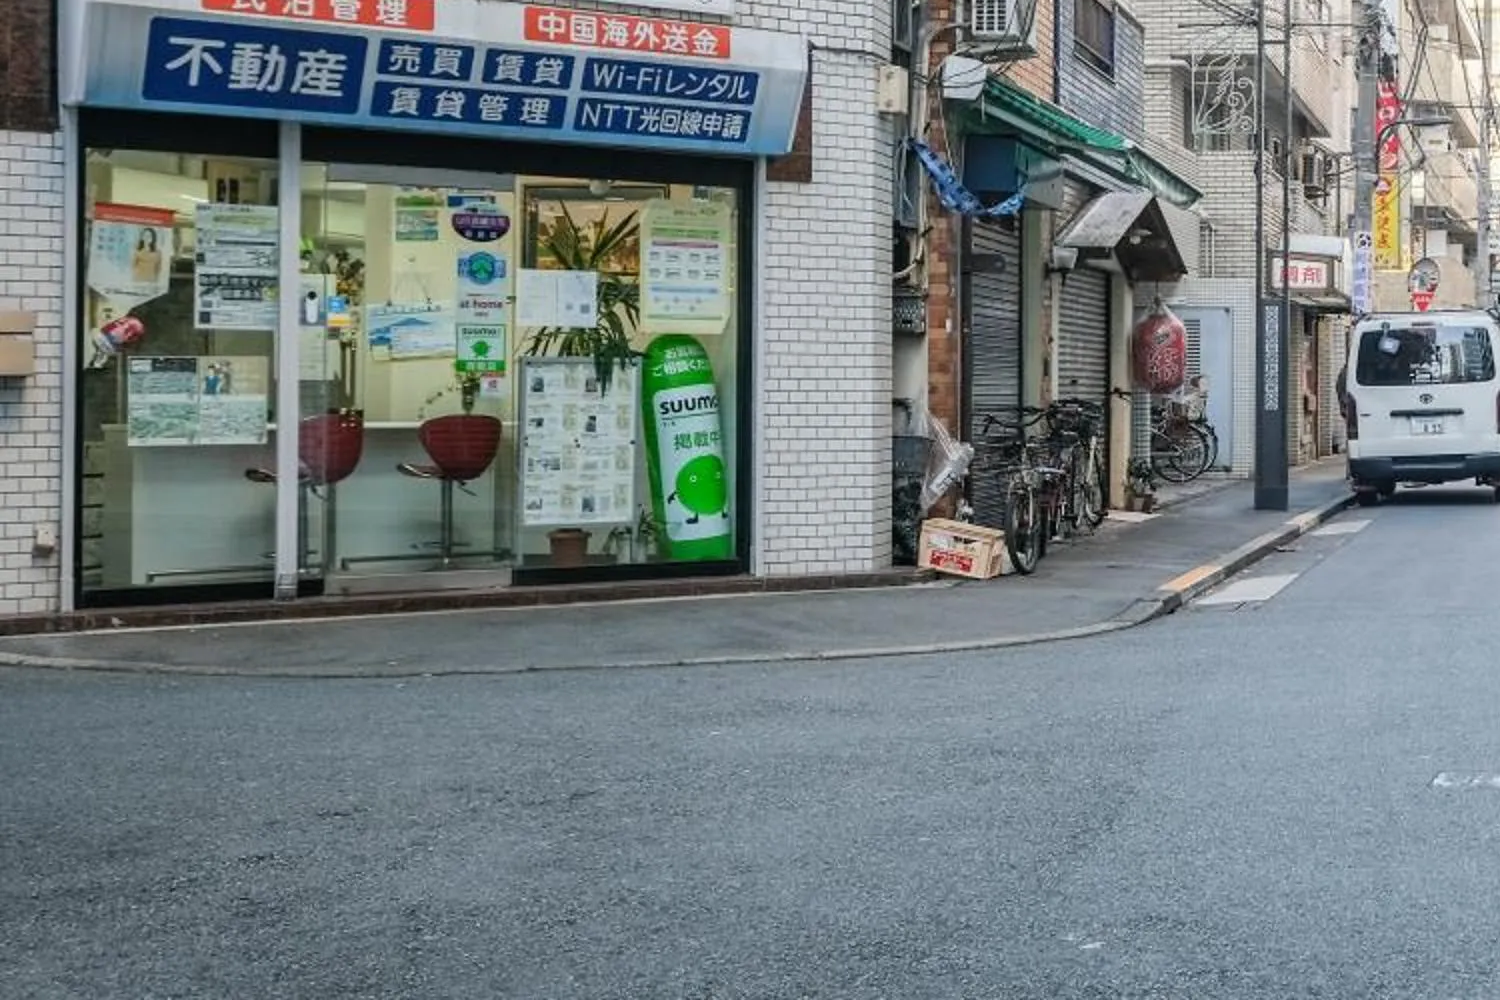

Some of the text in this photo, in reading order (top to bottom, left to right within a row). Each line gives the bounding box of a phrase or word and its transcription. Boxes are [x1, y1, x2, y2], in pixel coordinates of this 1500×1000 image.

[538, 12, 718, 55] 中国海外送金
[164, 36, 348, 97] 不動産
[389, 44, 462, 77] 売買
[494, 53, 564, 85] 賃貸
[593, 63, 750, 99] Wi-Fiレンタル
[388, 86, 552, 125] 賃貸管理
[581, 103, 745, 140] NTT光回線申請
